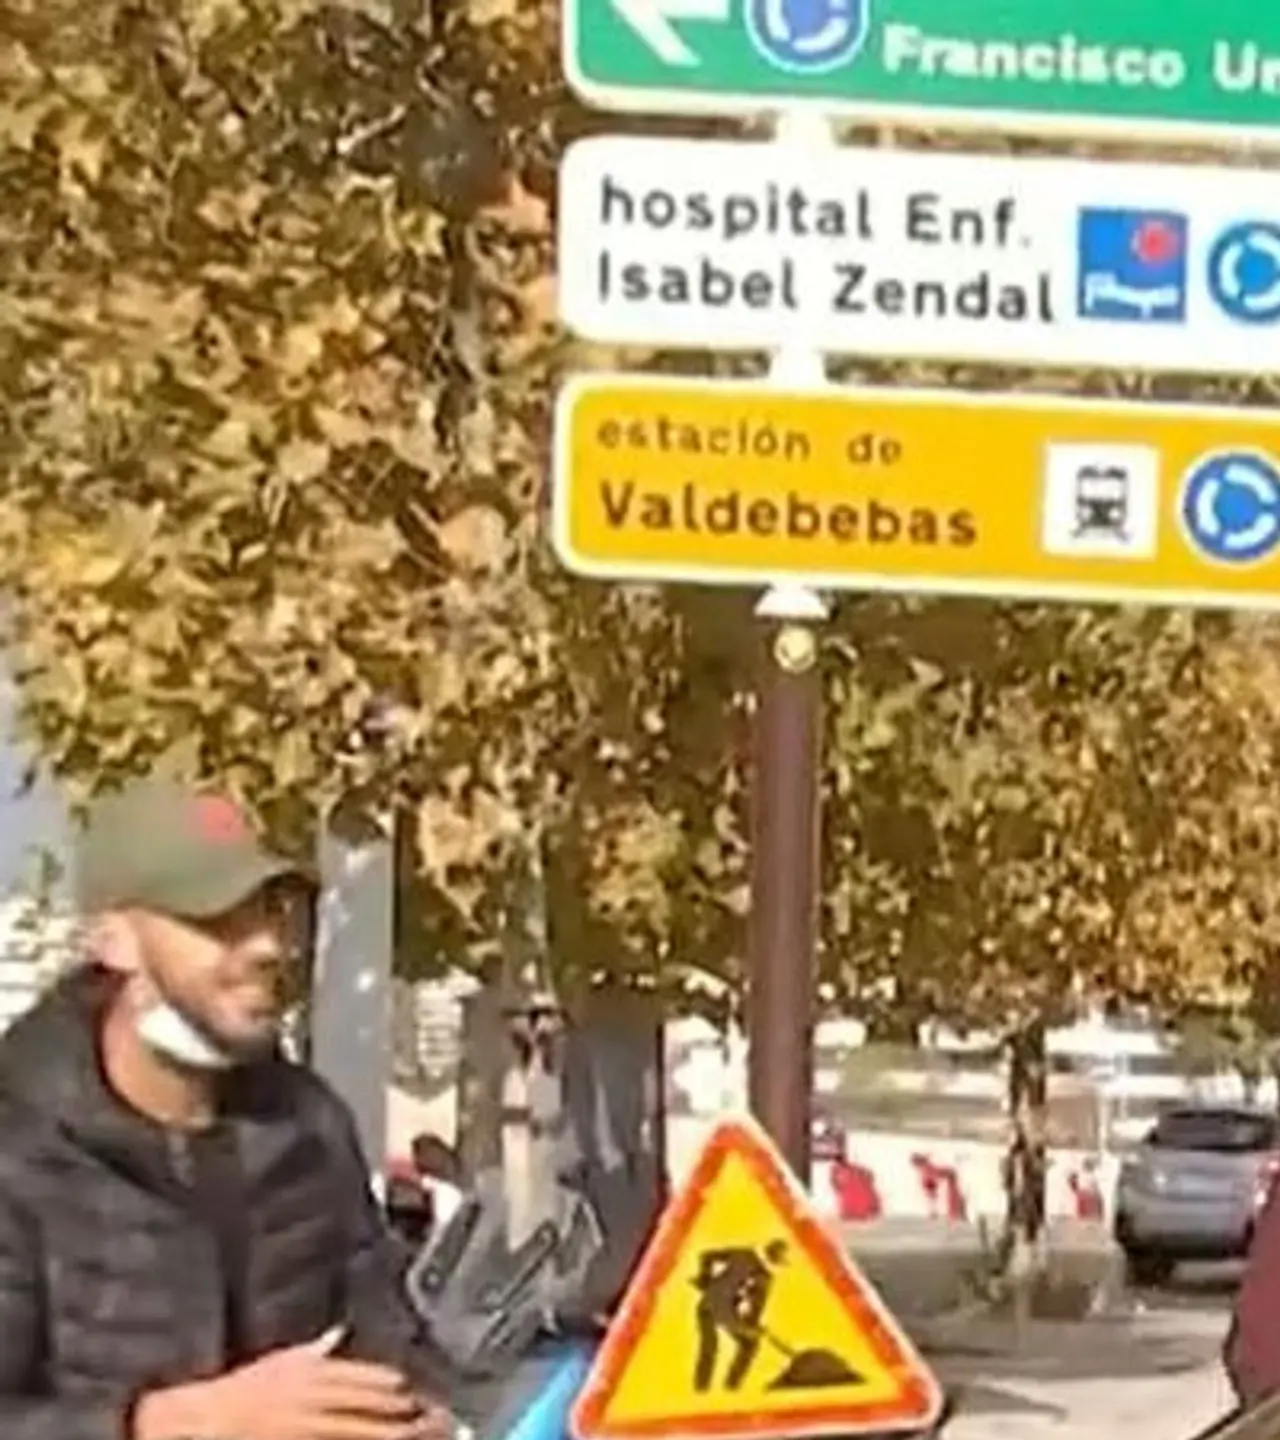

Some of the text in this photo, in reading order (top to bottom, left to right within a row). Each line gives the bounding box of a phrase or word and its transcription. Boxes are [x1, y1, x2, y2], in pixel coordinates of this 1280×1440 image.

[882, 22, 1186, 88] Francisco
[599, 173, 1033, 248] hospital Enf.
[599, 249, 1055, 324] Isabel Zendal
[597, 414, 904, 465] estación de
[599, 478, 979, 547] Valdebebas
